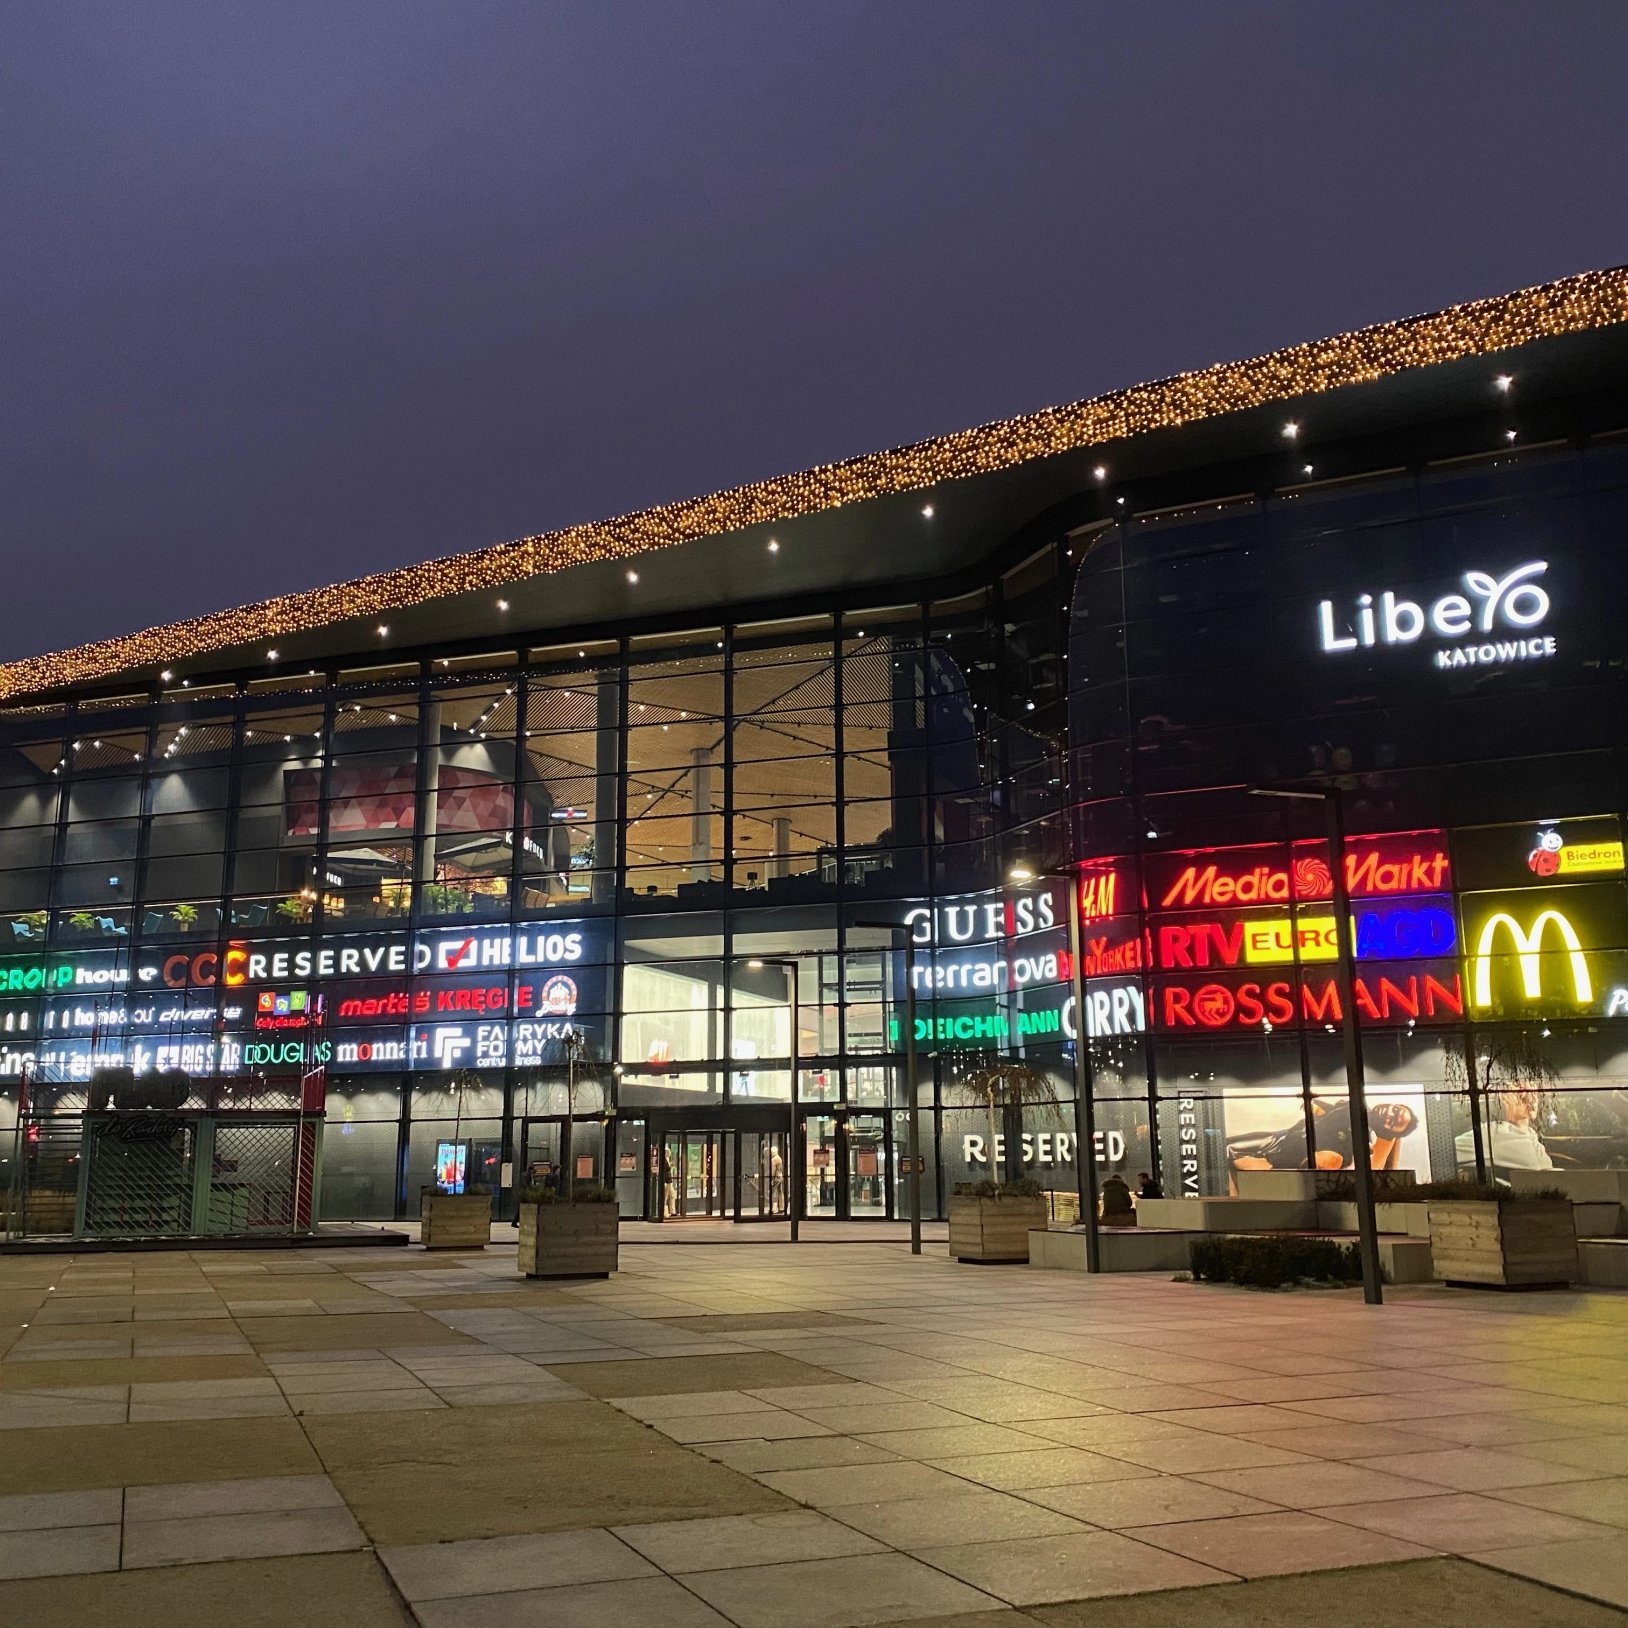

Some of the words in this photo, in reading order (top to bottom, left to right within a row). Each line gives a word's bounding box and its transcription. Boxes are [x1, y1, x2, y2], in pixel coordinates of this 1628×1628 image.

[1318, 561, 1549, 652] Libero
[1434, 636, 1558, 669] KATOWICE
[1162, 865, 1290, 907] Media
[903, 892, 1055, 943] GUESS
[481, 934, 583, 966] HELIOS
[1159, 923, 1246, 967] RTV
[1354, 910, 1456, 960] AGD
[75, 967, 159, 984] houe
[163, 950, 248, 988] CCC
[249, 945, 432, 979] RESERVED
[1163, 973, 1463, 1026] ROSSMANN
[206, 1044, 241, 1072] SAR
[963, 1131, 1124, 1163] RESERED
